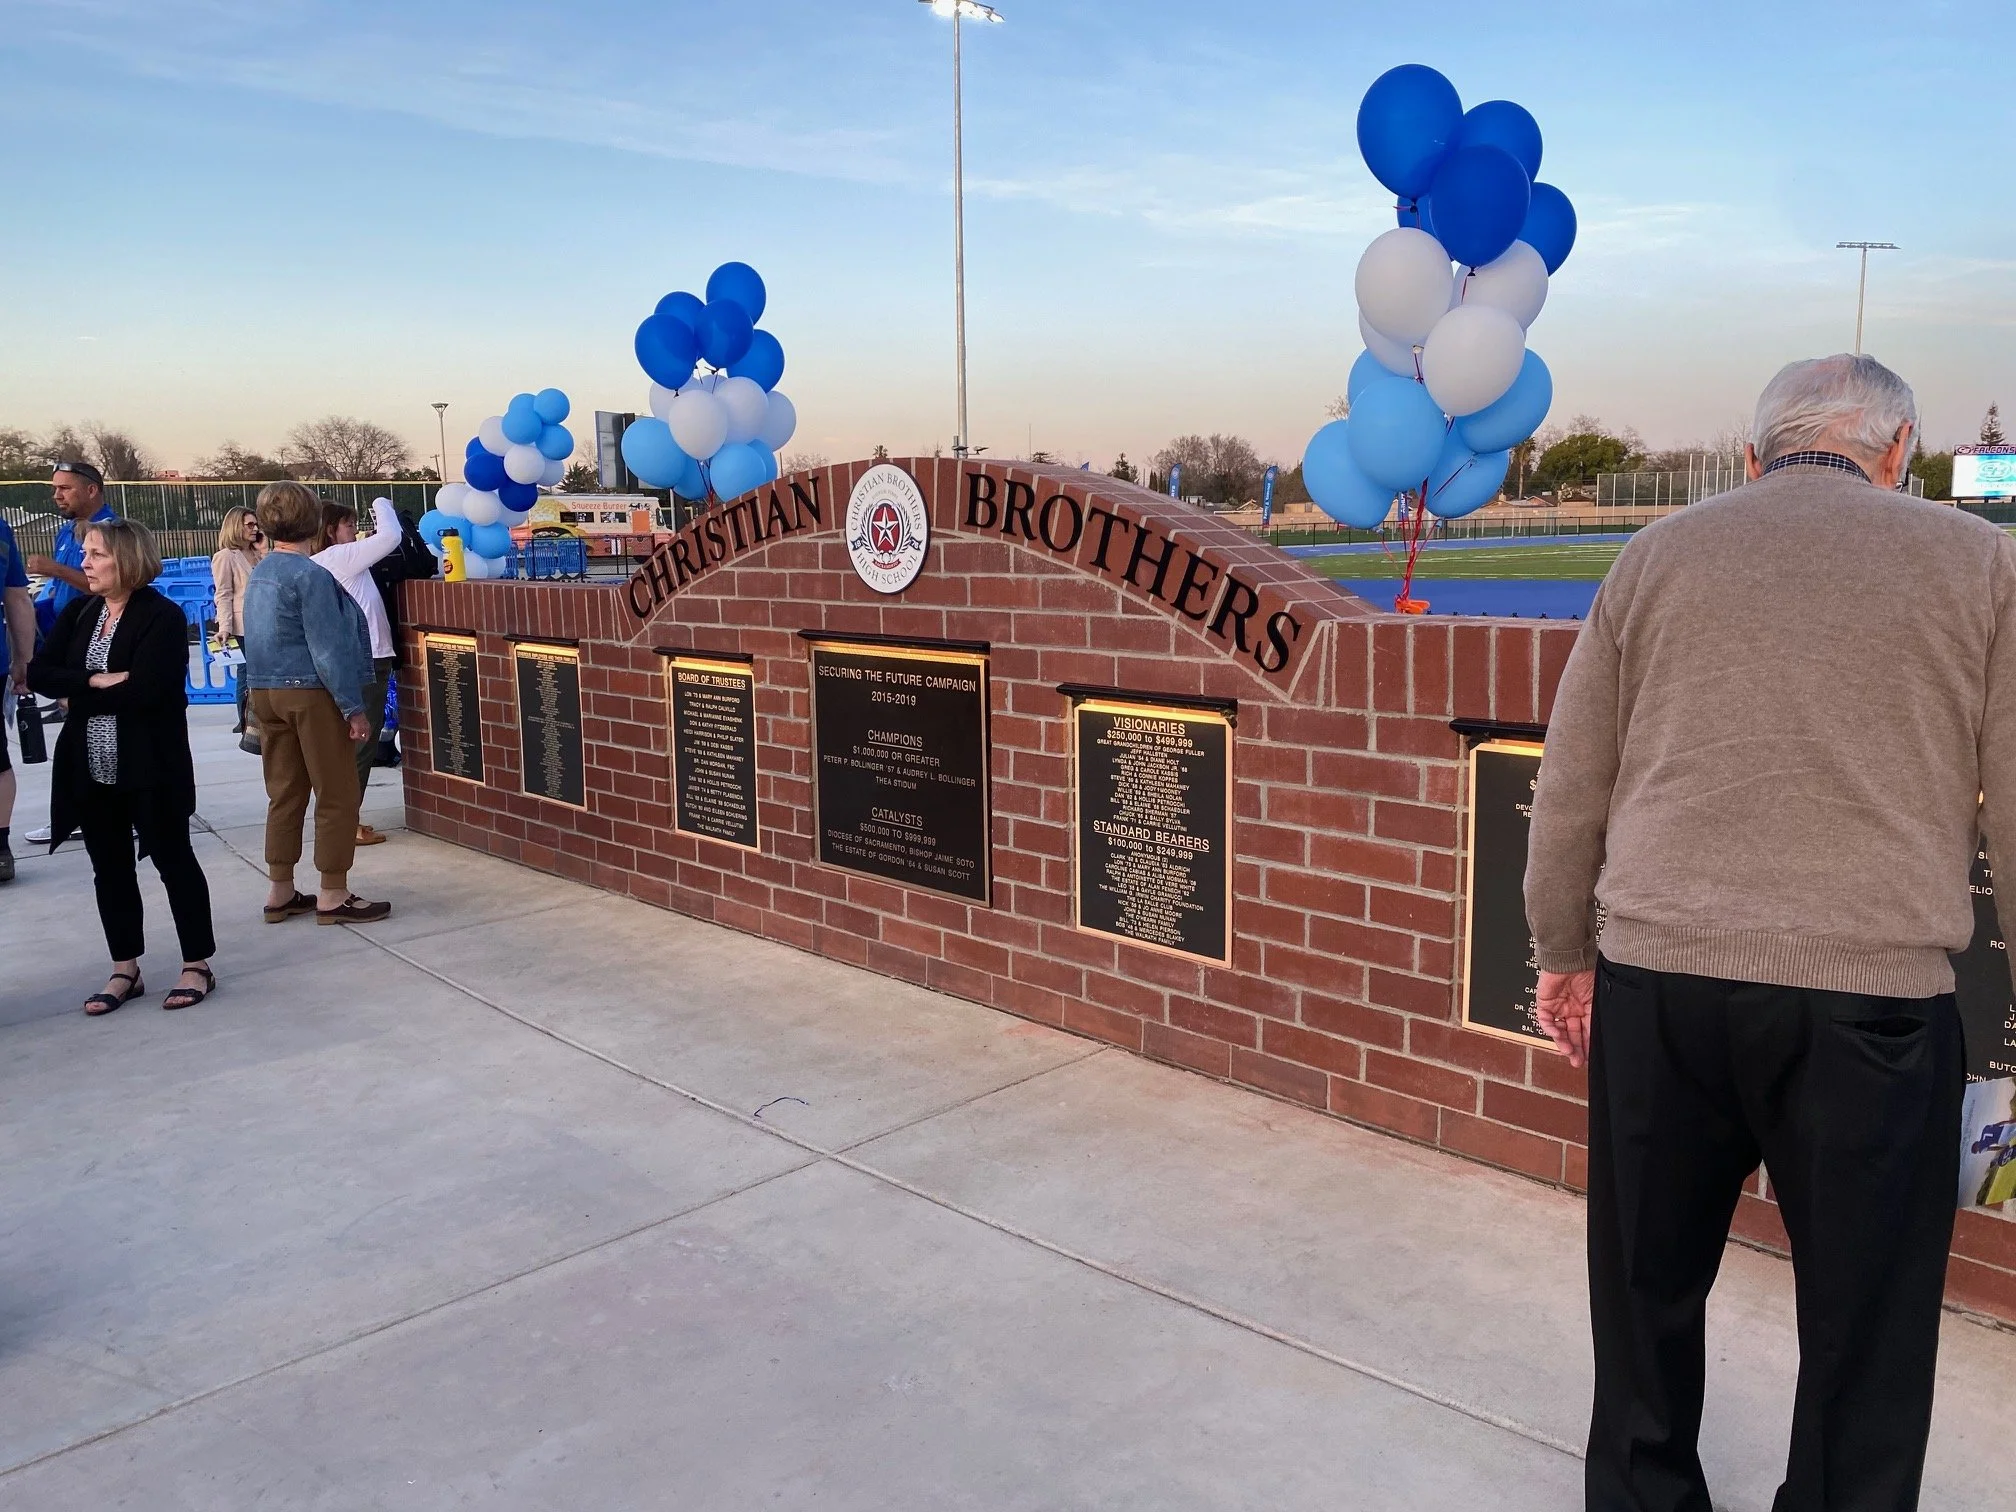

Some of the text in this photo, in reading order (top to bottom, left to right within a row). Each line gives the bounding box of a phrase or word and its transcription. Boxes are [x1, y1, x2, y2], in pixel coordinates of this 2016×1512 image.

[1973, 446, 2015, 454] FALCONS
[571, 501, 627, 510] Squeeze Burger
[851, 472, 922, 531] CHRISTIAN BROTHERS
[630, 472, 1301, 672] CHRISTIAN BROTHERS
[856, 552, 918, 585] HIGH SCHOOL
[678, 672, 745, 688] BOARD OF TRUSTEES
[819, 664, 976, 692] SECURING THE FUTURE CAMPAIGN
[872, 690, 916, 707] 2015-2019
[1114, 716, 1185, 735] VISIONARIES
[868, 729, 922, 748] CHAMPIONS
[1107, 729, 1193, 749] $250,000 to $499,999
[853, 745, 940, 769] $1,000,000 OR GREATER
[1113, 740, 1153, 751] GRANDCHILDREN
[1163, 746, 1183, 755] GEORGE
[1185, 749, 1204, 757] FULLER
[824, 754, 842, 766] PETER
[851, 759, 884, 773] BOLLINGER
[886, 764, 894, 774] '57
[897, 766, 901, 775] &
[903, 767, 928, 780] AUDREY
[938, 773, 975, 788] BOLLINGER
[1140, 767, 1159, 775] CAROLE
[876, 776, 916, 790] THEA STIDUM
[1516, 803, 1534, 811] DEVO
[872, 806, 922, 827] CATALYSTS
[1143, 820, 1161, 828] CARRIE
[860, 822, 936, 847] $500,000 TO $999,999
[1094, 820, 1209, 850] STANDARD BEARERS
[828, 829, 852, 843] DIOCESE
[855, 835, 862, 845] OF
[909, 846, 932, 860] BISHOP
[935, 852, 953, 864] JAIME
[956, 856, 974, 869] SOTO
[1108, 837, 1193, 861] $100,000 to $249,999
[1131, 851, 1160, 862] ANONYMOUS
[832, 843, 843, 853] THE
[845, 846, 866, 858] ESTATE
[868, 851, 876, 860] OF
[878, 853, 904, 867] GORDON
[918, 862, 922, 870] &
[924, 863, 945, 876] SUSAN
[948, 868, 970, 881] SCOTT
[1106, 868, 1121, 876] RALPH
[1127, 873, 1155, 883] ANTOINETTE
[1179, 883, 1195, 892] WHITE
[1122, 877, 1138, 886] ESTATE
[1163, 869, 1186, 878] BURFORD
[1109, 886, 1127, 895] WILLIAM
[1150, 895, 1171, 904] CHARITY
[1173, 900, 1203, 911] FOUNDATION
[1144, 899, 1158, 907] SALLE
[1124, 906, 1136, 914] JOHN
[1142, 910, 1158, 919] SUSAN
[1159, 914, 1176, 923] NUNAN
[1143, 922, 1158, 930] HELEN
[1158, 920, 1174, 928] FAMILY
[1158, 937, 1174, 946] FAMILY
[1514, 1003, 1525, 1012] DR.
[1521, 1025, 1534, 1034] SAL
[1989, 1061, 2016, 1074] BUTC
